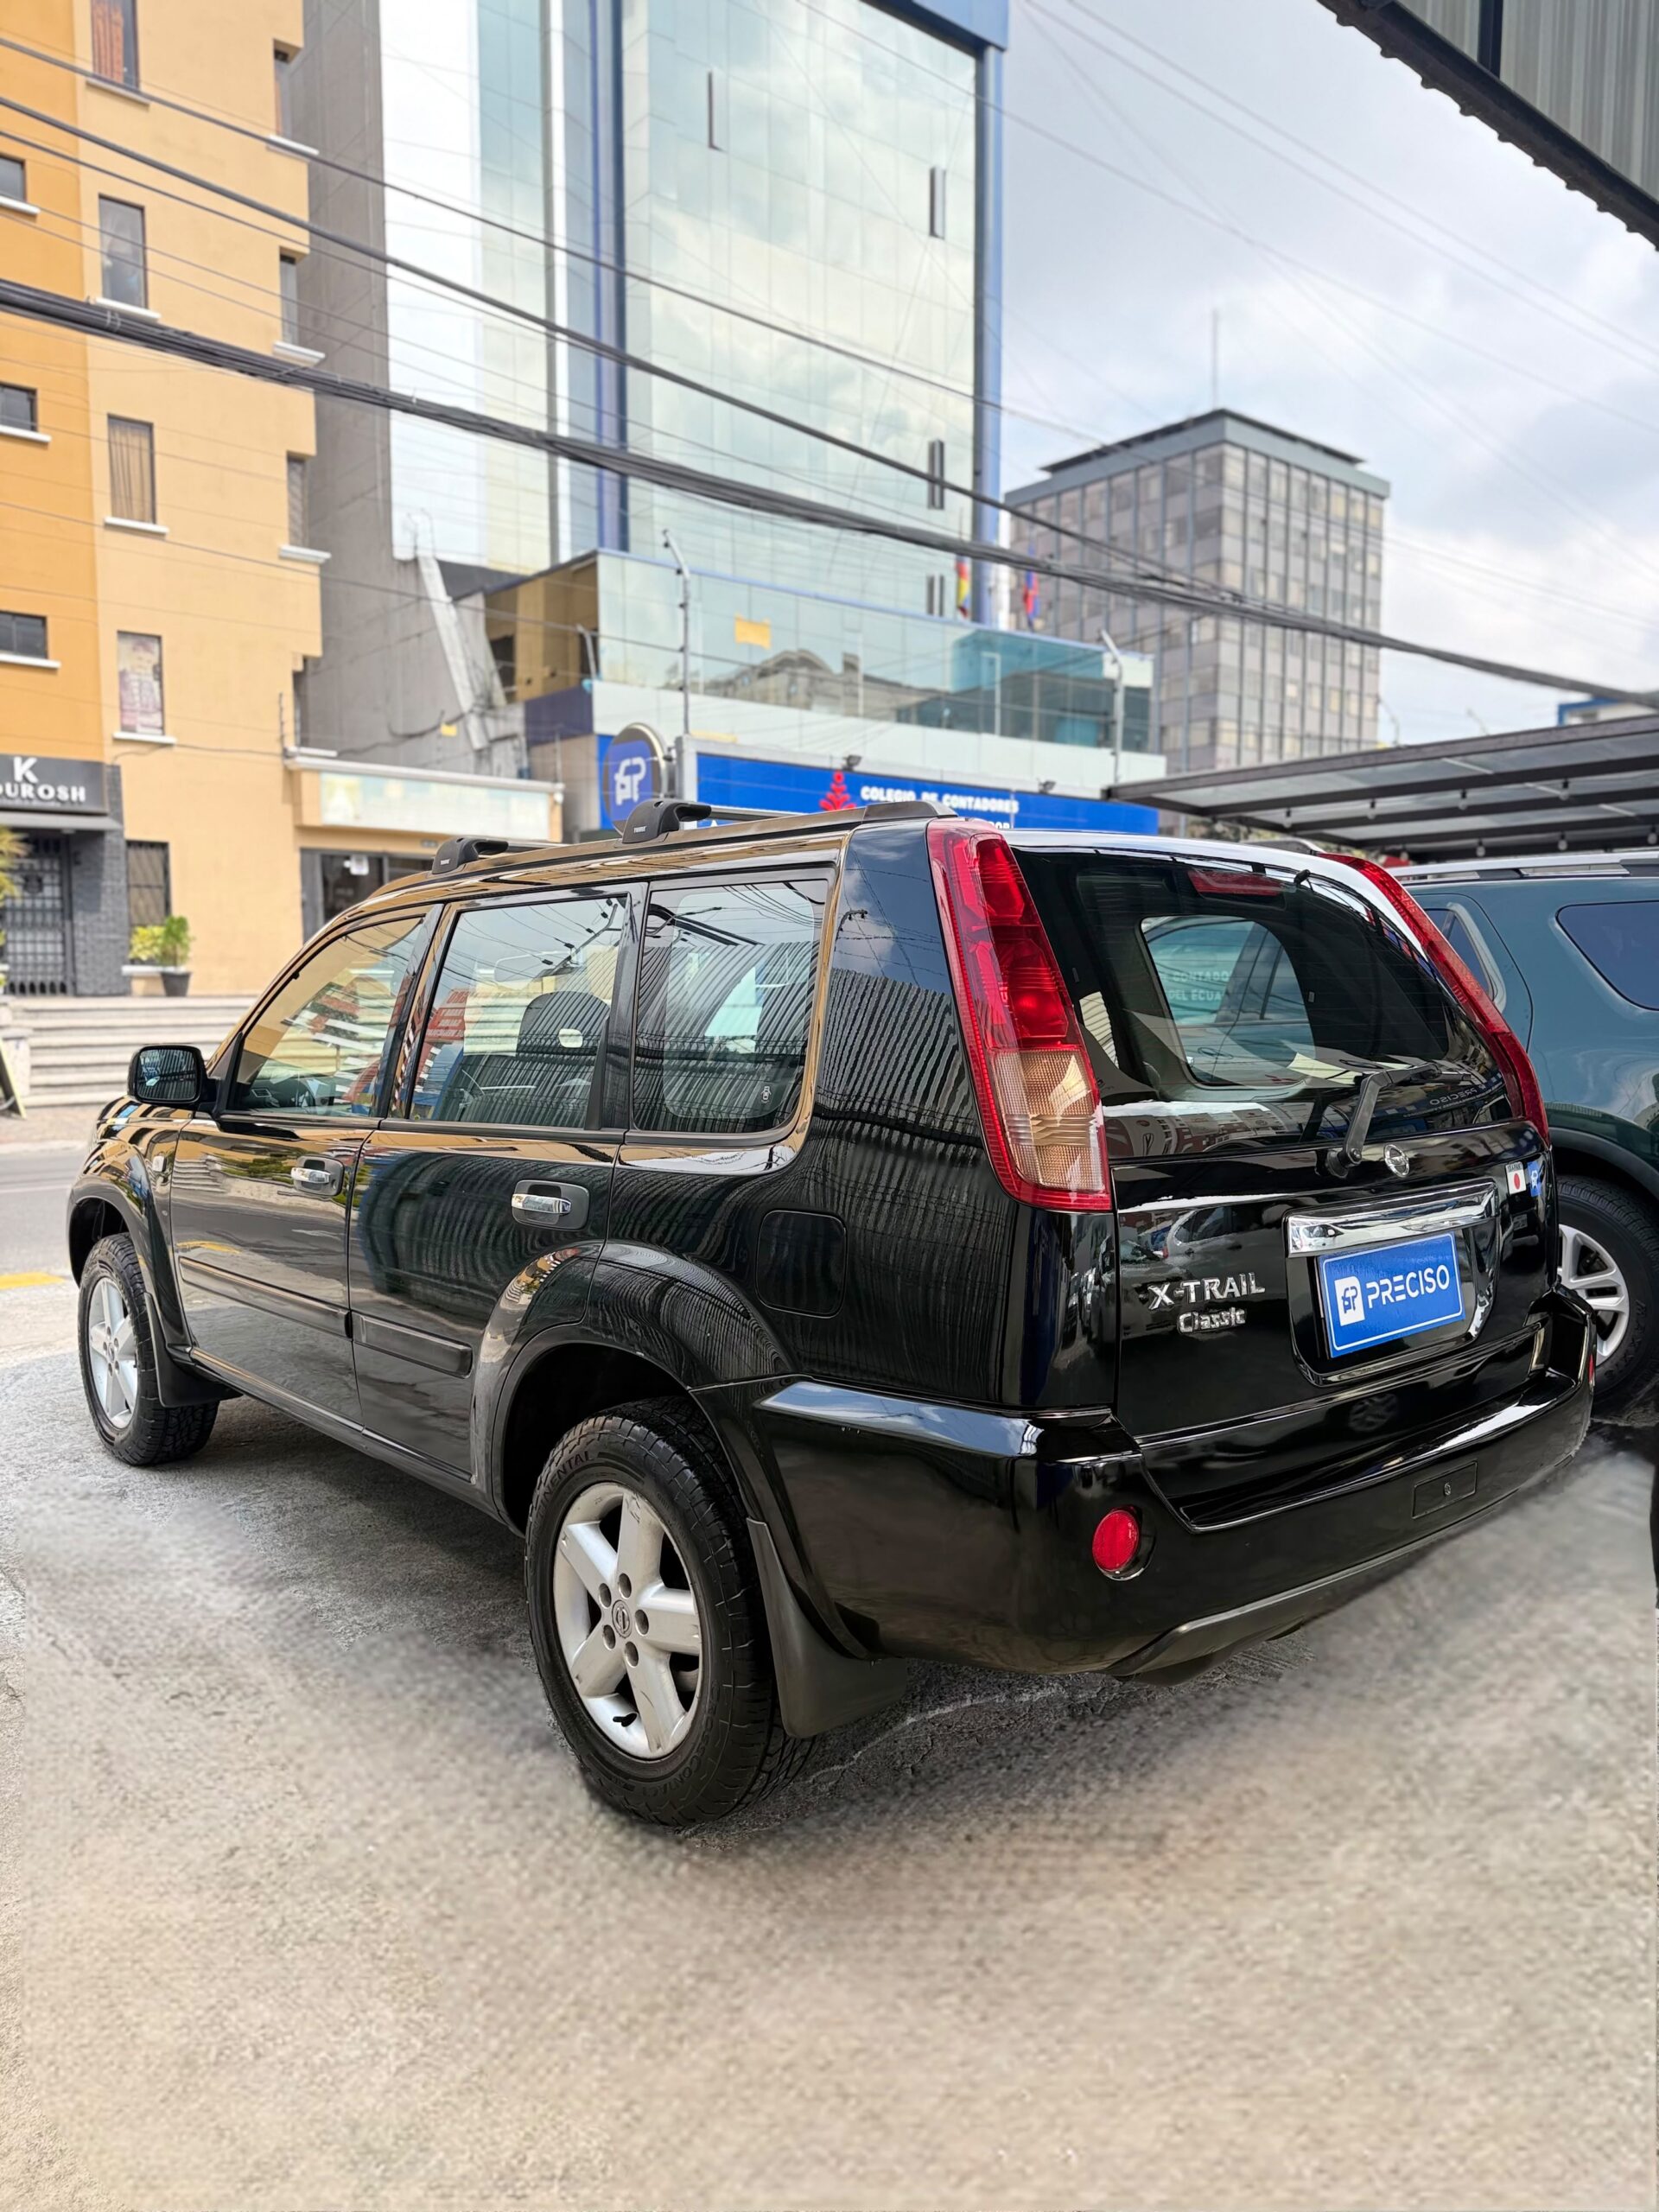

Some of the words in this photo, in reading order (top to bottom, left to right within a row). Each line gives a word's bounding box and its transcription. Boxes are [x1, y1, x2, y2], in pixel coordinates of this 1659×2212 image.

[13, 756, 39, 783] K
[0, 782, 86, 802] UROSH
[860, 785, 917, 802] COLEGIO
[942, 793, 1020, 814] CONTADORES
[1147, 1272, 1266, 1311] X-TRAIL
[1365, 1264, 1450, 1309] PRECISO
[1177, 1306, 1246, 1333] Classic
